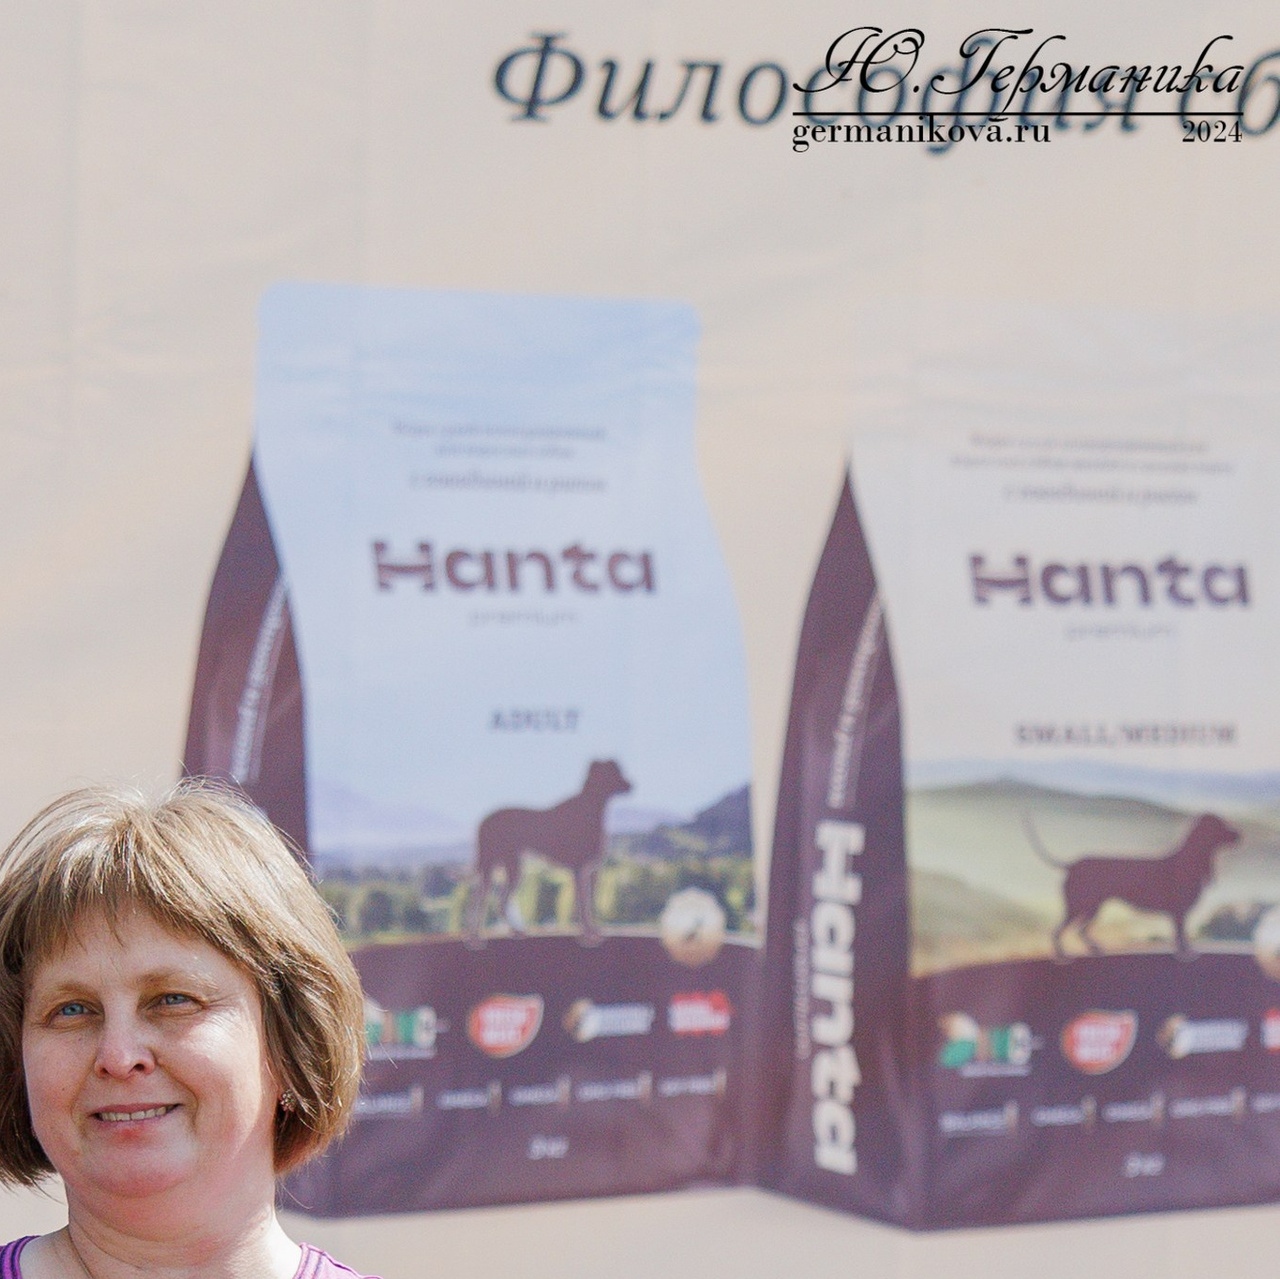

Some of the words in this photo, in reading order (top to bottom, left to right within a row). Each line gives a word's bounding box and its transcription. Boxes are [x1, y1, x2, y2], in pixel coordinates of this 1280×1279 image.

[372, 540, 657, 594] Hanta
[969, 552, 1253, 608] Hanta
[812, 819, 866, 1176] Hanta
